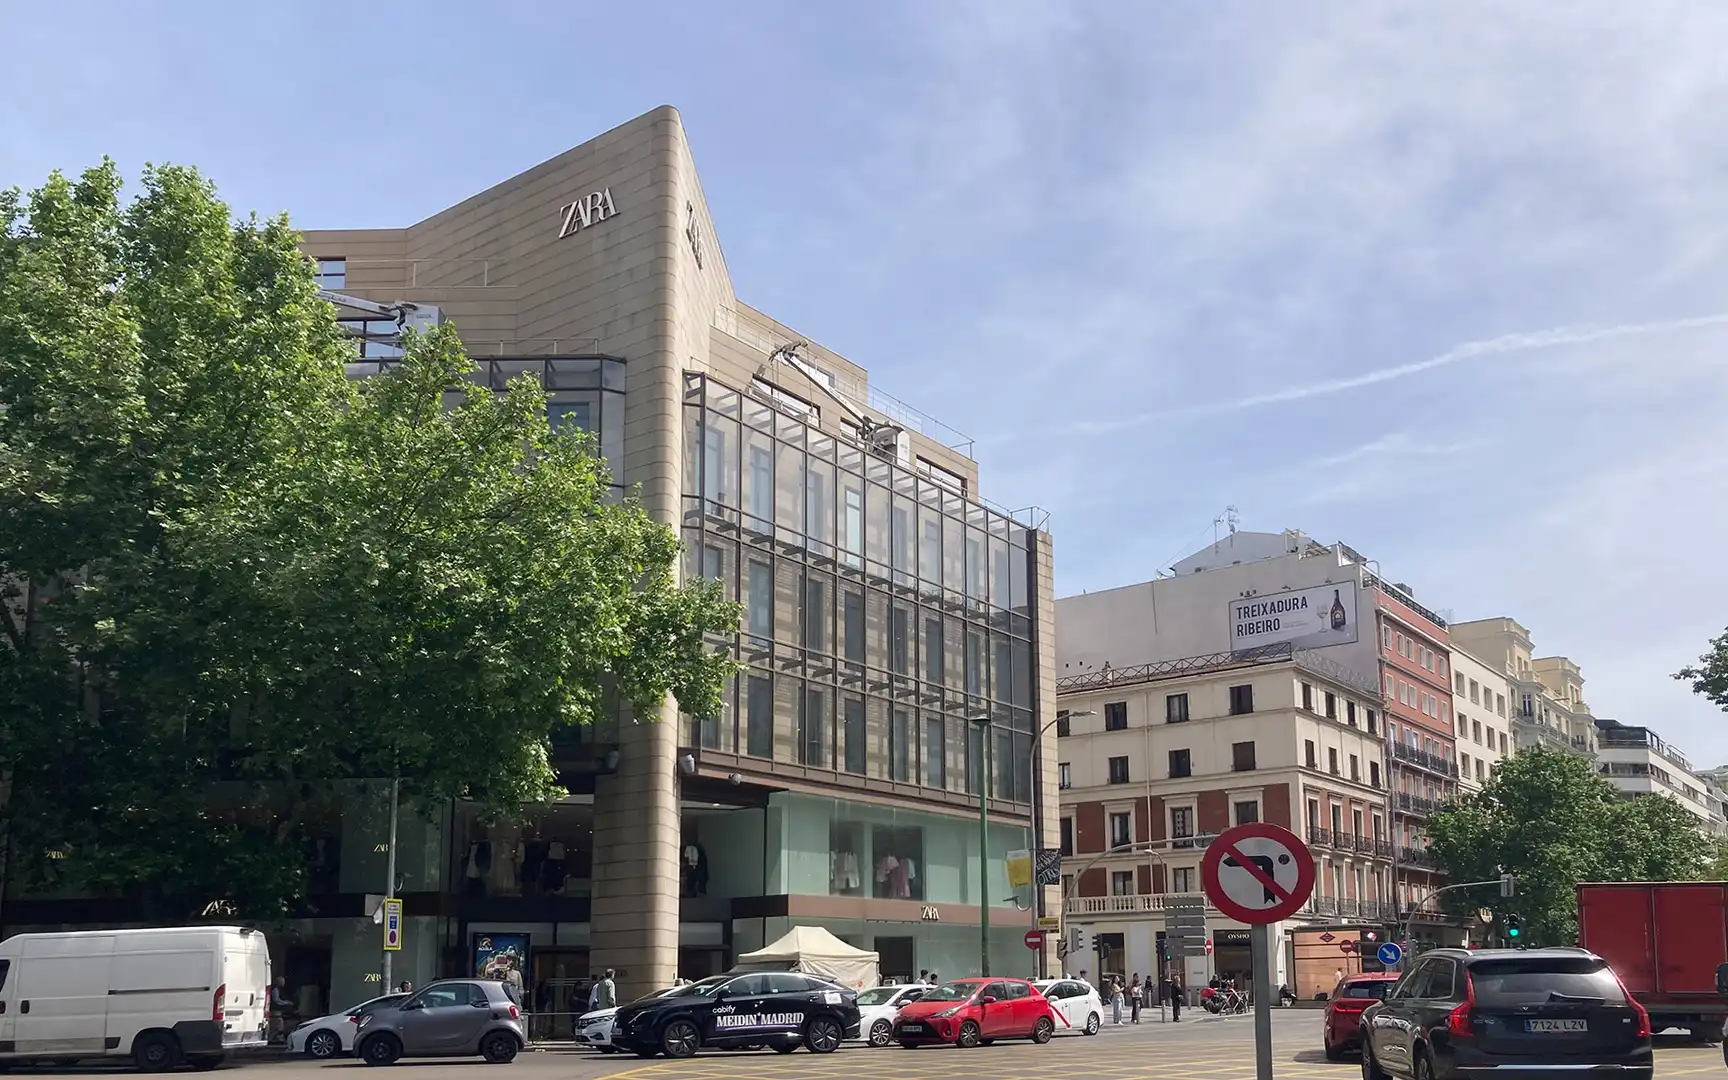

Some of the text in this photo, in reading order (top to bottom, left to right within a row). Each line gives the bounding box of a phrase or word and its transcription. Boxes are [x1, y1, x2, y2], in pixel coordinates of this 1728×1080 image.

[558, 186, 620, 239] ZARA
[1236, 596, 1308, 620] TREIXADURA
[1236, 618, 1280, 637] RIBEIRO
[921, 905, 940, 919] ZARA
[712, 1005, 736, 1014] cabify
[716, 1012, 805, 1028] MEIDIN MADRID
[1531, 1020, 1585, 1030] 7124 LZV
